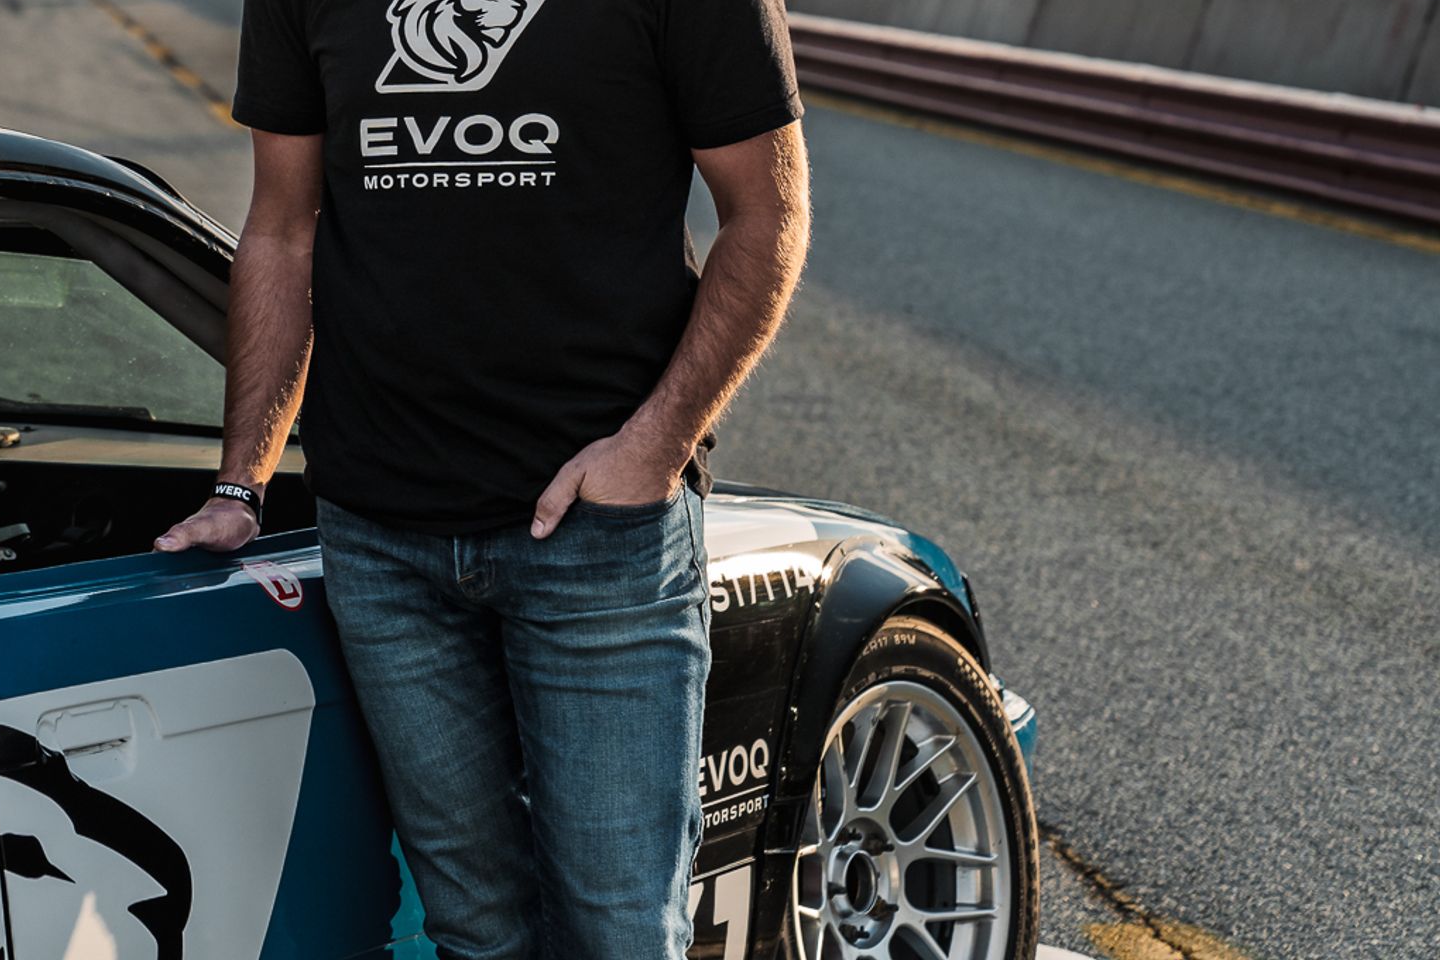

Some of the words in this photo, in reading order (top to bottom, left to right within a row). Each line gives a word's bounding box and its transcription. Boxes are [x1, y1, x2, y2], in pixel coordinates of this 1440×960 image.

[359, 112, 560, 157] EVOQ
[364, 171, 556, 190] MOTORSPORT
[215, 485, 252, 501] WERC
[700, 794, 769, 828] TORSPORT
